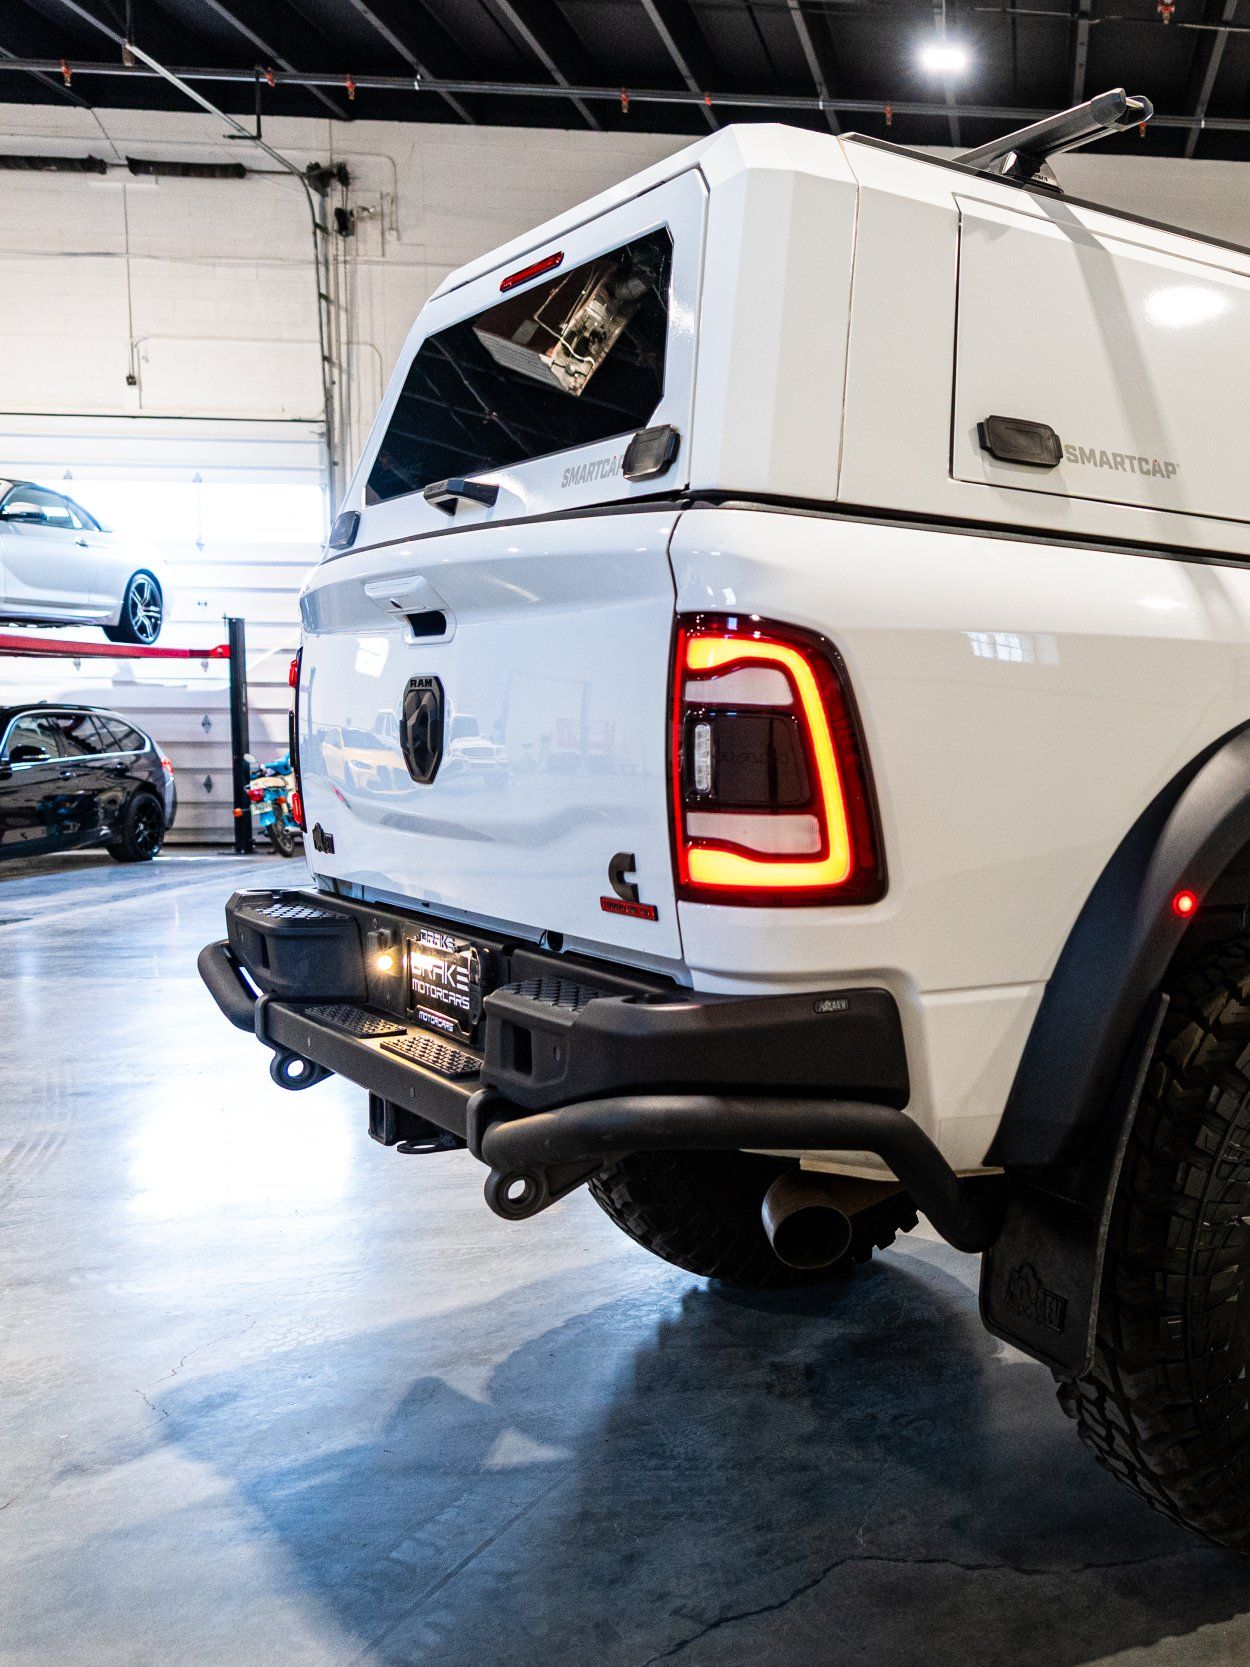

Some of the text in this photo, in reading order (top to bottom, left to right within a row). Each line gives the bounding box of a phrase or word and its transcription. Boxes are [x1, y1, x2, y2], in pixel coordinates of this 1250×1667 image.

[1064, 444, 1177, 479] SMARTCAP
[410, 679, 433, 688] RAM
[412, 978, 470, 1010] MOTORCARS
[418, 1011, 454, 1033] MOTORCARS
